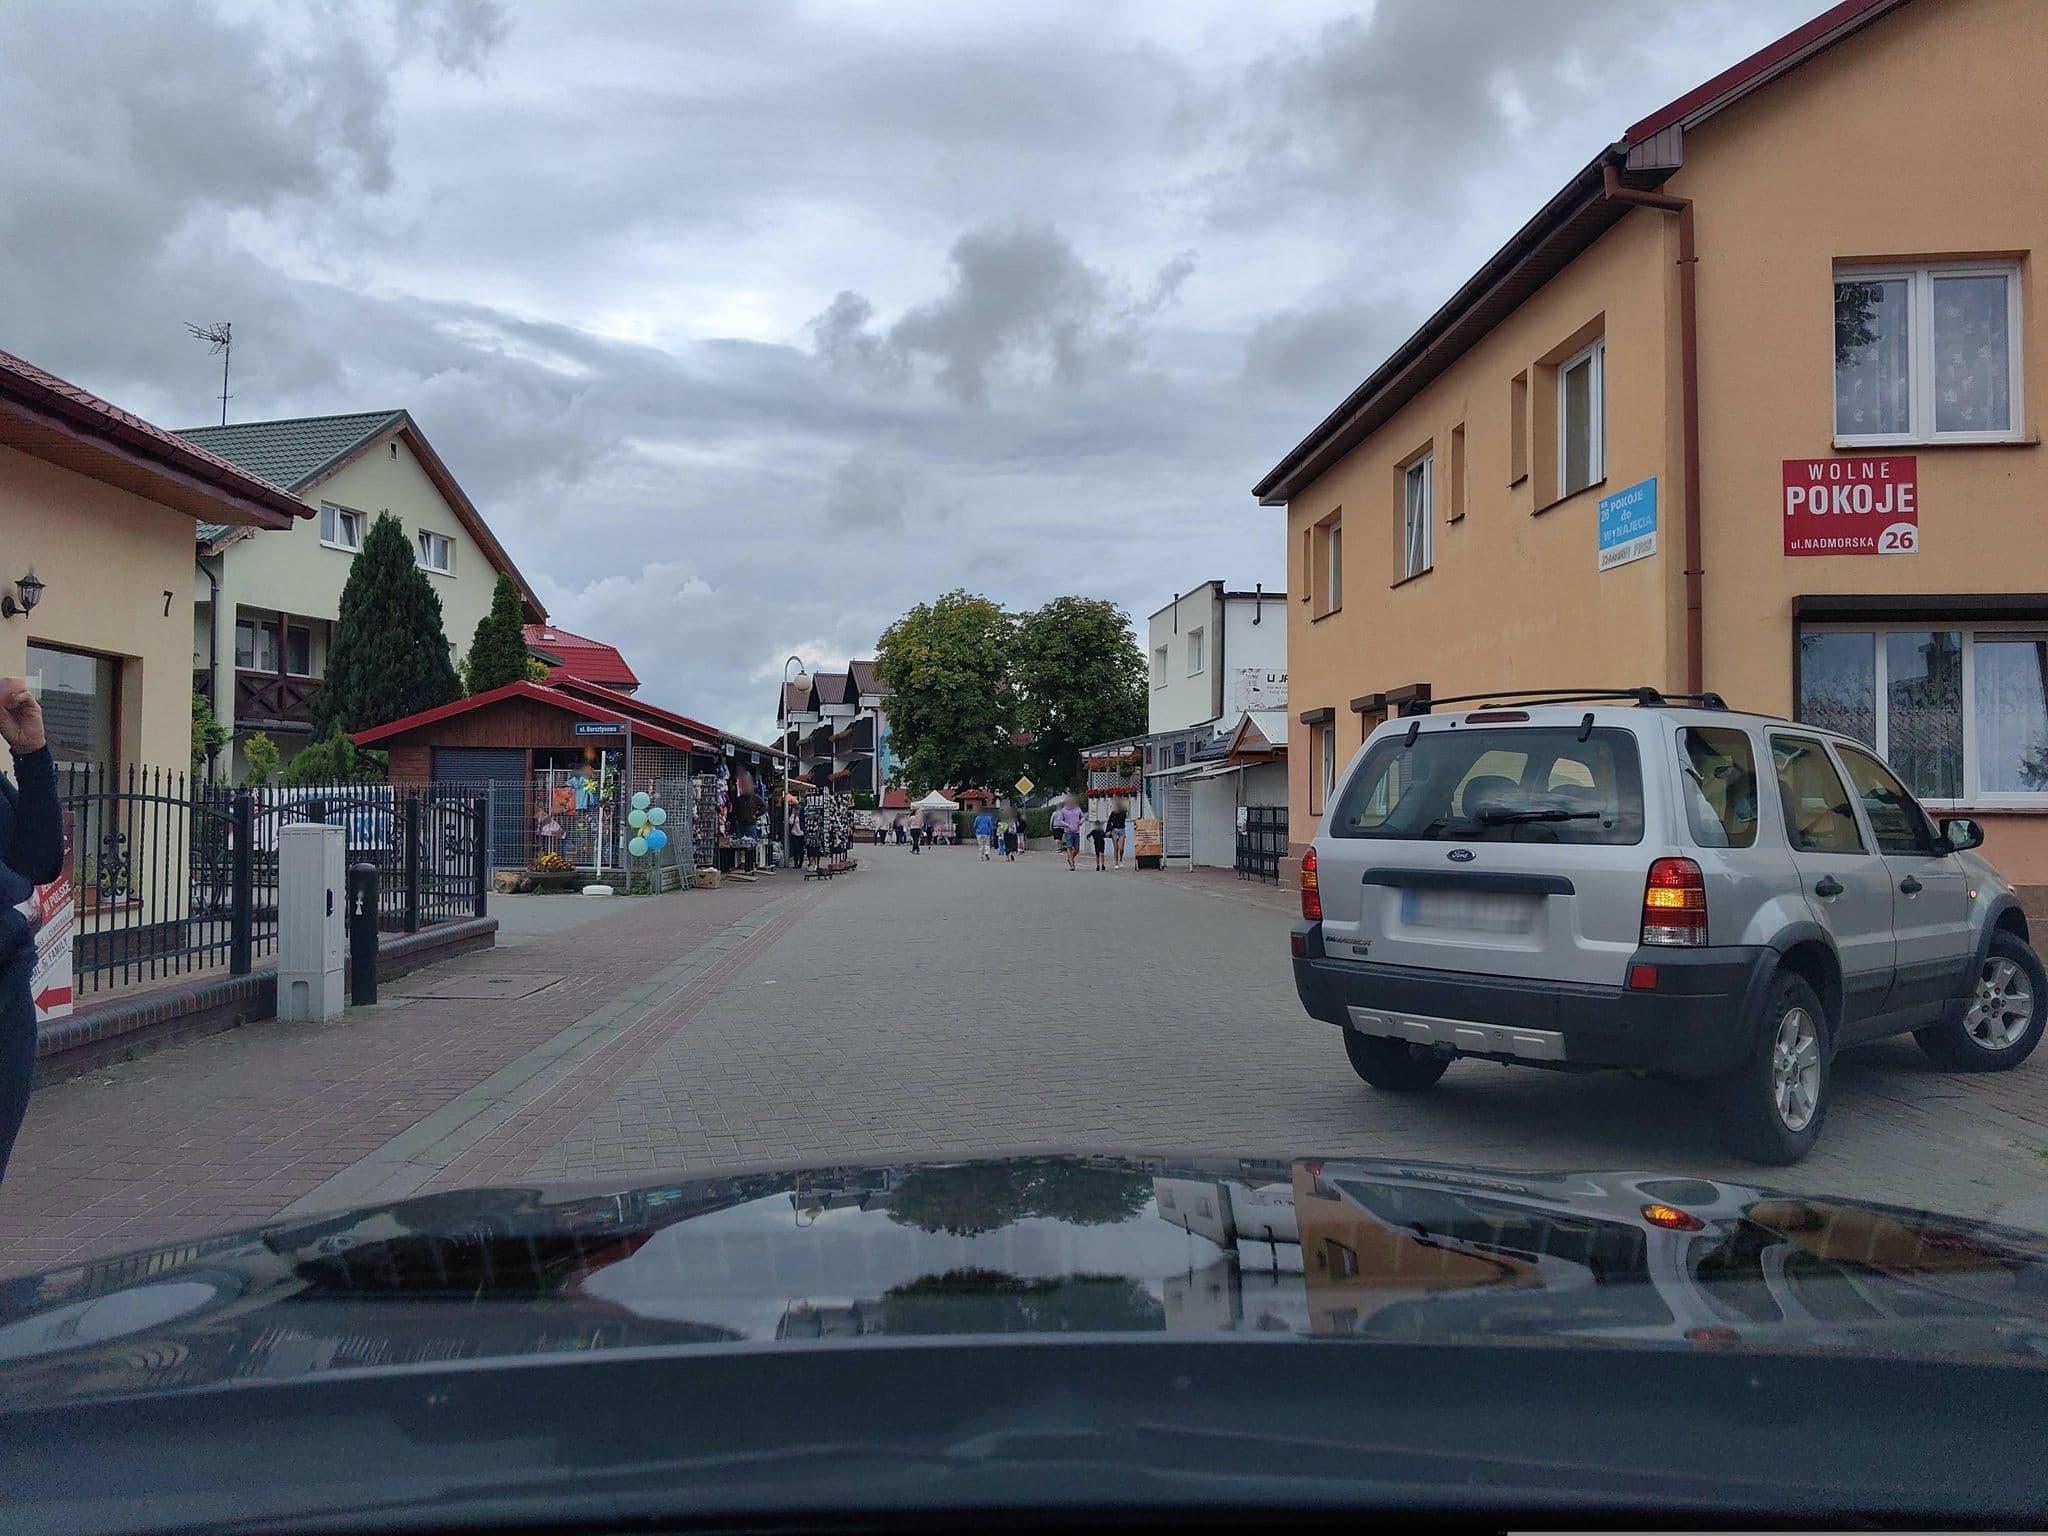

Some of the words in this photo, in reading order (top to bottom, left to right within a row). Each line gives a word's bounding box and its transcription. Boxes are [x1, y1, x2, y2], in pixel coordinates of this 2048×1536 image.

[1808, 462, 1890, 480] WOLNE
[1610, 489, 1644, 513] POKOJE
[1786, 483, 1915, 515] POKOJE
[1600, 508, 1610, 522] 26
[1620, 508, 1632, 521] do
[1885, 531, 1914, 549] 26
[163, 590, 174, 617] 7
